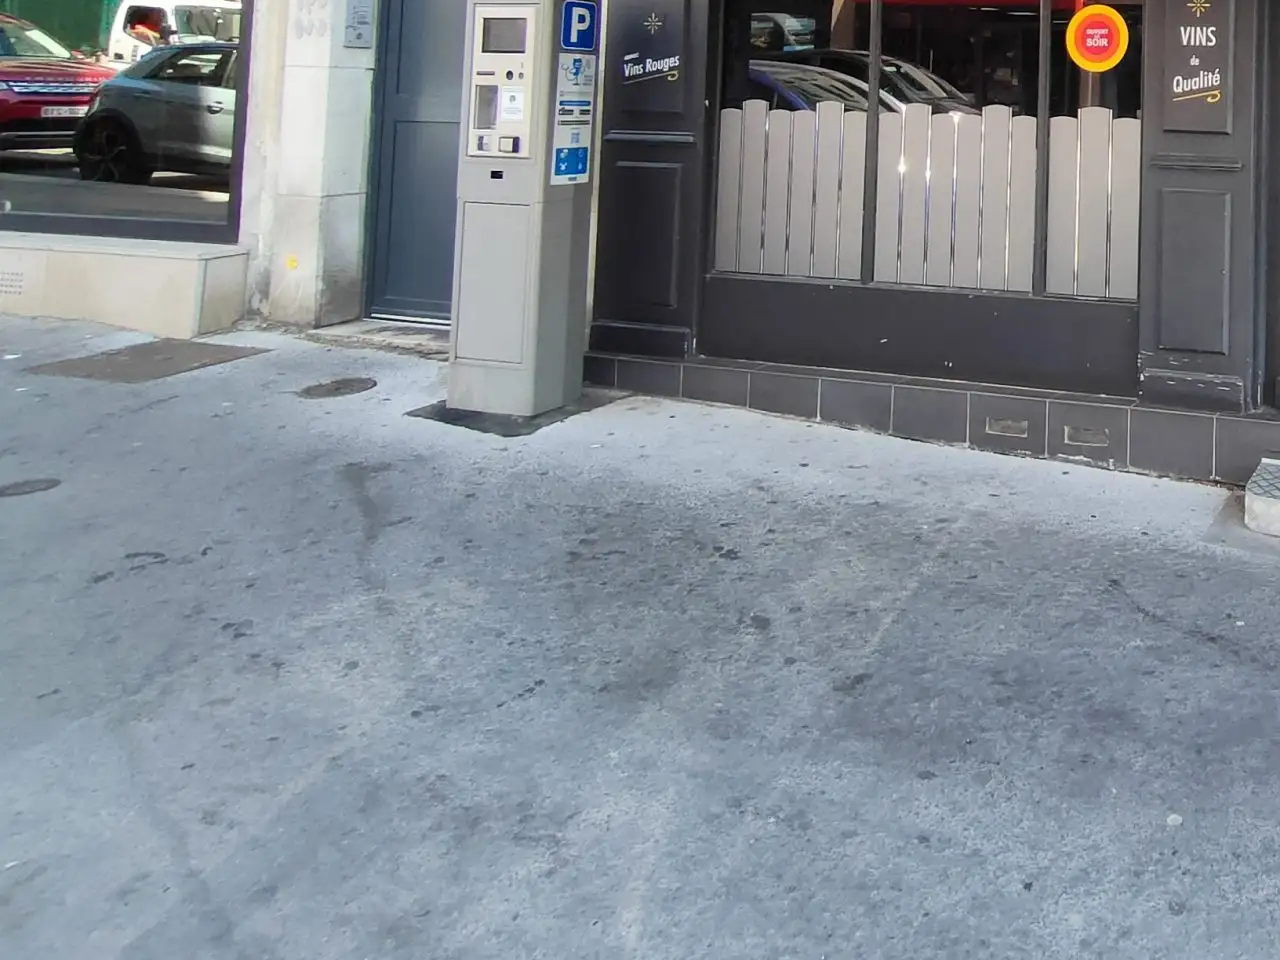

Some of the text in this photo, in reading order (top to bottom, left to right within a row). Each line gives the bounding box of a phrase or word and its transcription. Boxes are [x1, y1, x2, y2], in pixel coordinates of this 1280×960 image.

[570, 7, 591, 43] P
[1086, 38, 1109, 47] SOIR
[1180, 26, 1217, 46] VINS
[624, 63, 644, 77] Vins
[645, 56, 680, 72] Rouges
[1190, 54, 1200, 66] de
[1173, 69, 1221, 93] Qualité
